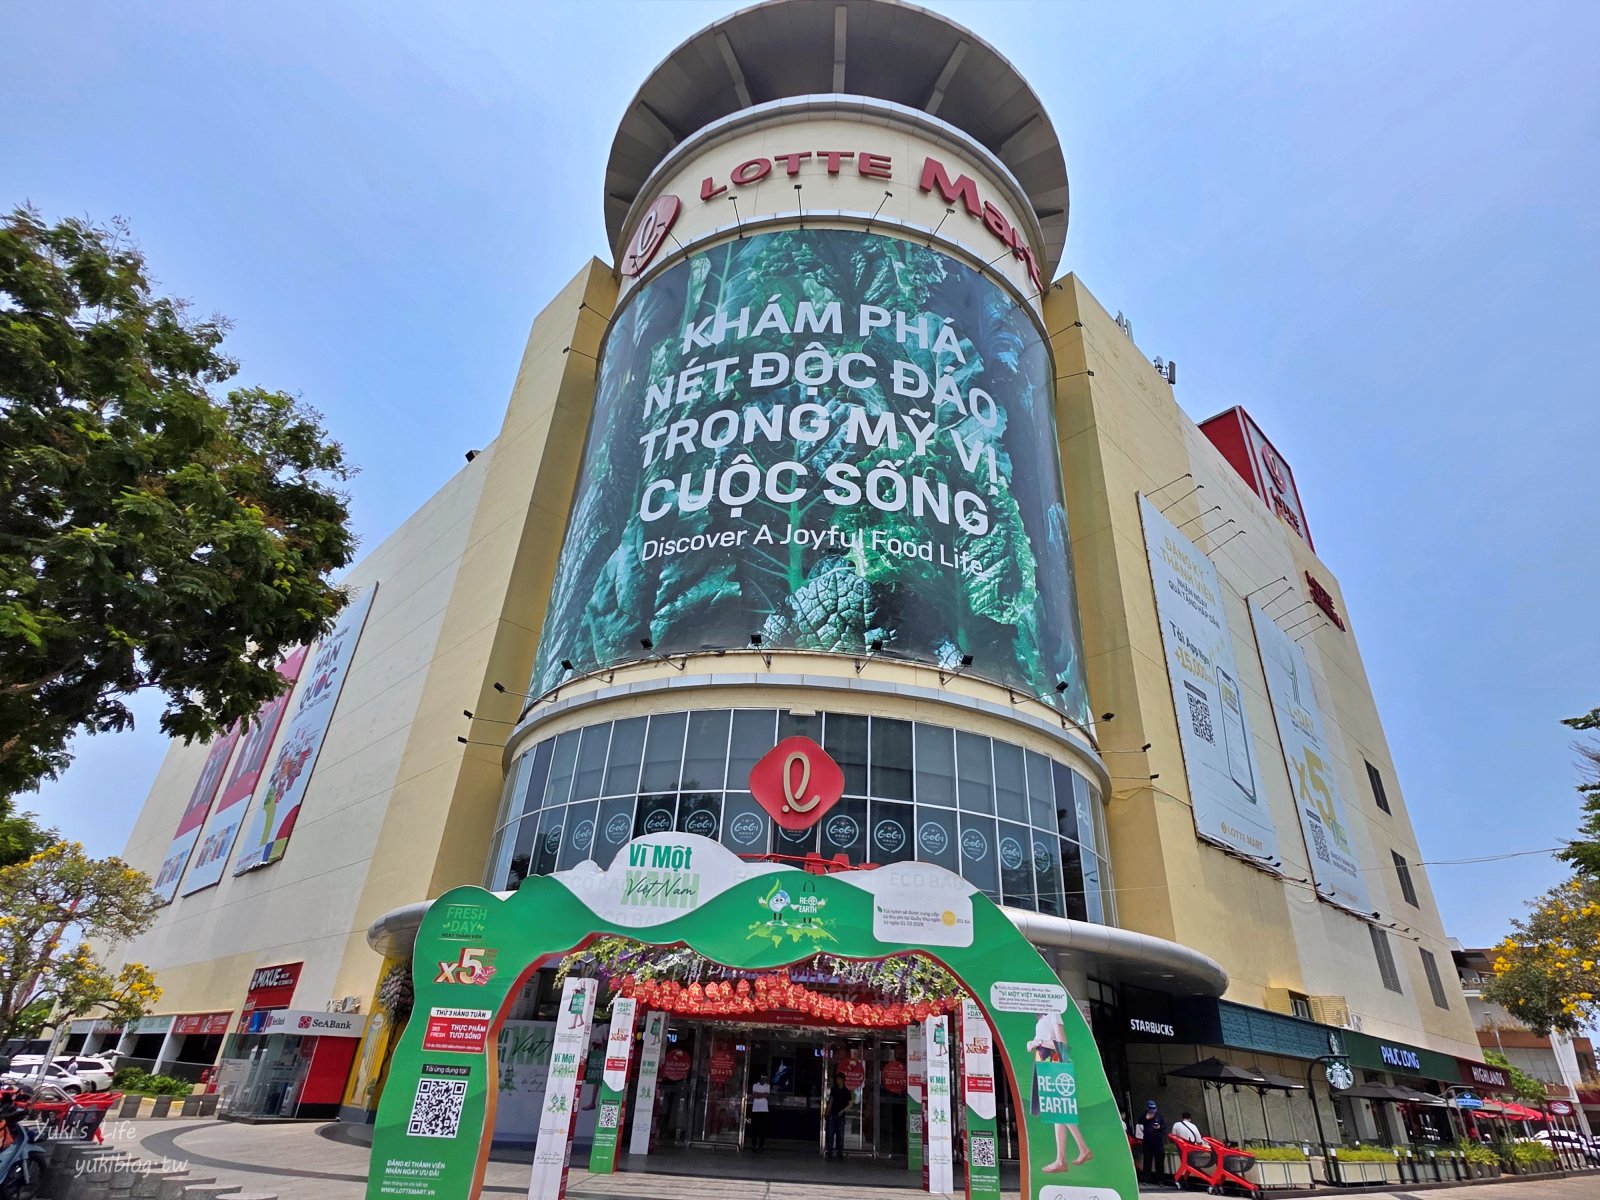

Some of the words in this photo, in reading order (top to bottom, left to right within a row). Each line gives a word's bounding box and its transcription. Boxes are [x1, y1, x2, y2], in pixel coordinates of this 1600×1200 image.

[700, 151, 893, 201] LOTTE
[919, 157, 1044, 292] Mart
[682, 293, 843, 356] KHÁM
[859, 303, 967, 364] PHÁ
[642, 355, 739, 421] NÉT
[748, 341, 877, 396] ĐỘC
[890, 362, 997, 430] ĐÁO
[639, 404, 830, 469] TRONG
[846, 407, 939, 457] MỸ
[950, 428, 1000, 497] VỊ
[639, 454, 809, 523] CUỘC
[822, 459, 990, 536] SỐNG
[641, 526, 748, 562] Discover
[753, 525, 774, 547] A
[780, 524, 863, 552] Joyful
[872, 530, 933, 563] Food
[940, 548, 985, 578] Life
[629, 843, 653, 867] Vì
[652, 844, 692, 871] Một
[620, 870, 700, 908] XANH
[627, 877, 662, 898] Việt
[653, 877, 697, 898] Nam
[890, 873, 924, 888] ECO
[929, 876, 966, 891] BAG
[447, 907, 488, 920] FRESH
[451, 920, 478, 933] DAY
[434, 947, 486, 984] x5
[257, 968, 283, 987] MIXUE
[312, 1019, 352, 1029] SeABank
[451, 1024, 468, 1032] THỰC
[1130, 1018, 1174, 1037] STARBUCKS
[465, 1031, 482, 1040] SỐNG
[1400, 1050, 1420, 1069] LONG
[1472, 1066, 1505, 1086] HIGHLANDS
[1039, 1096, 1078, 1115] EARTH
